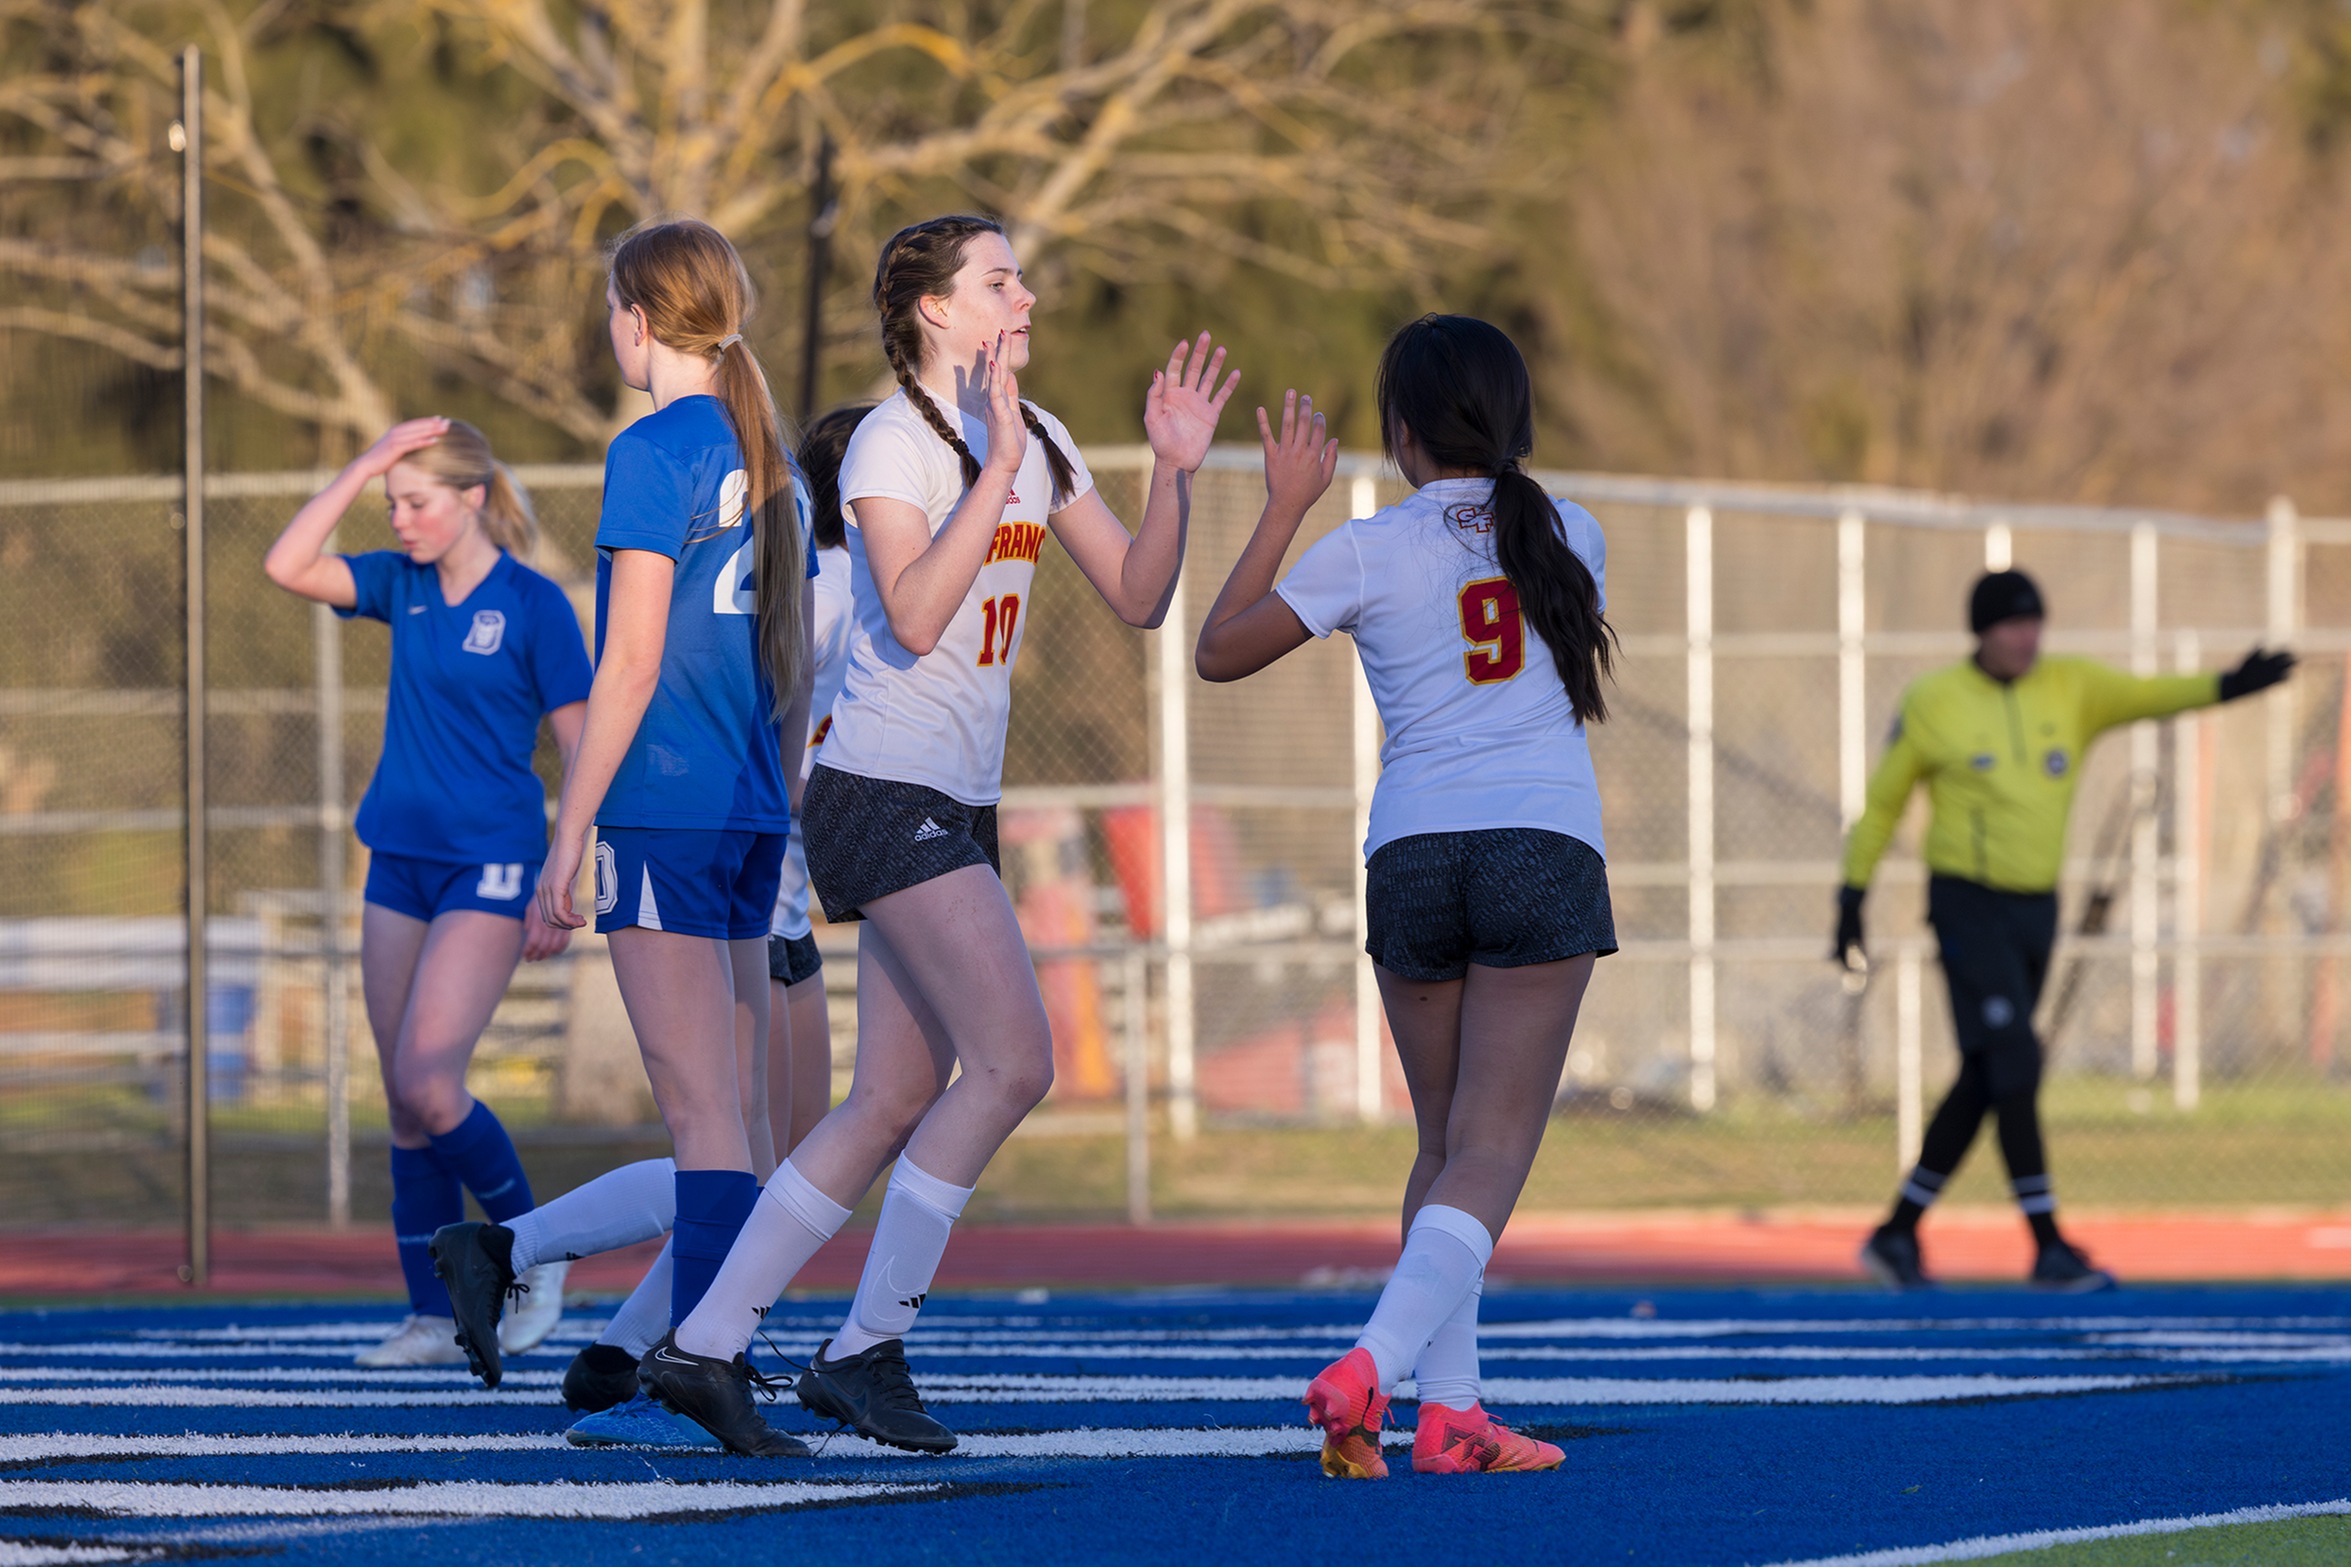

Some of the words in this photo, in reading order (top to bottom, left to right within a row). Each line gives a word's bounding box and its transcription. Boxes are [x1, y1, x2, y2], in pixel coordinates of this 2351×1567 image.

[976, 593, 1020, 667] 10
[1457, 575, 1525, 686] 9
[914, 828, 949, 842] adidas
